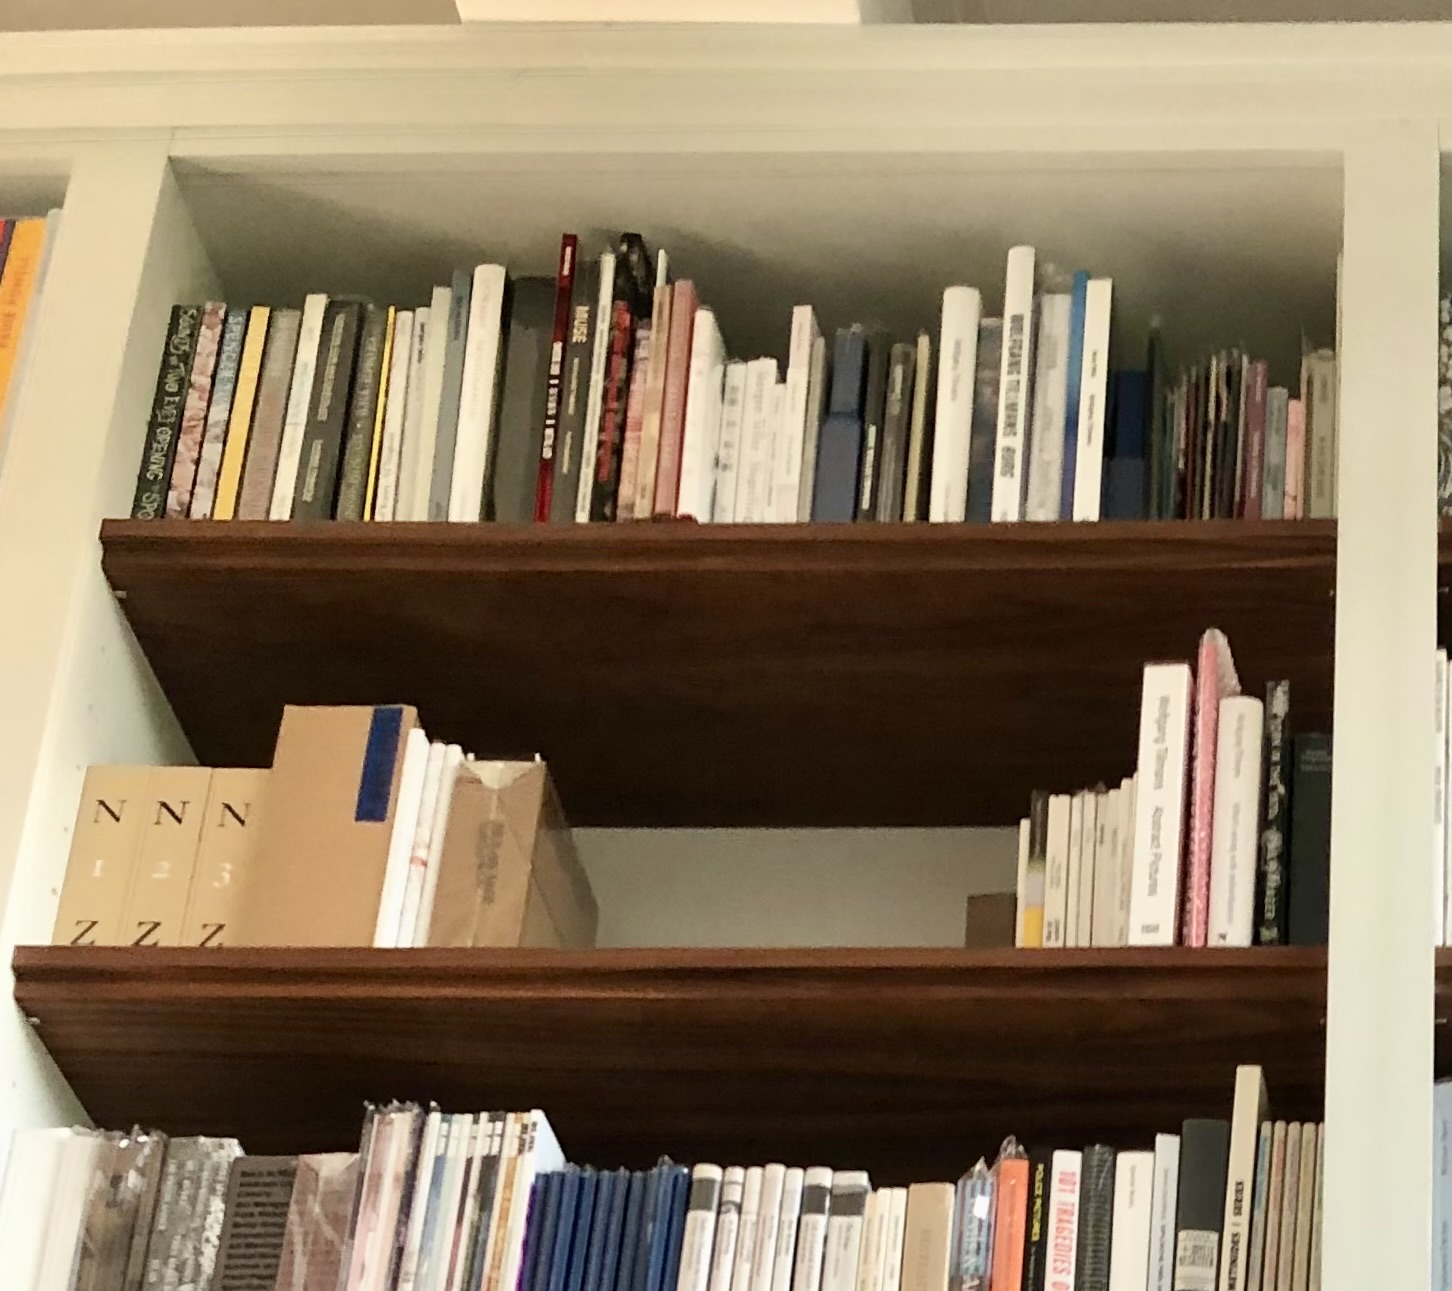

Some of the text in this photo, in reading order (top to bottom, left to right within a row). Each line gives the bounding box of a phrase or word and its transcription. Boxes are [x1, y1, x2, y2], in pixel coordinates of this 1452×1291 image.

[571, 305, 590, 343] MUSE
[164, 363, 185, 393] TWO
[147, 428, 173, 480] OPENING
[93, 800, 127, 823] N
[154, 800, 190, 825] N
[217, 801, 250, 828] N
[152, 861, 171, 879] 2
[213, 863, 232, 888] 3
[1057, 1170, 1078, 1196] 101
[1053, 1201, 1076, 1275] TRAGEDIES
